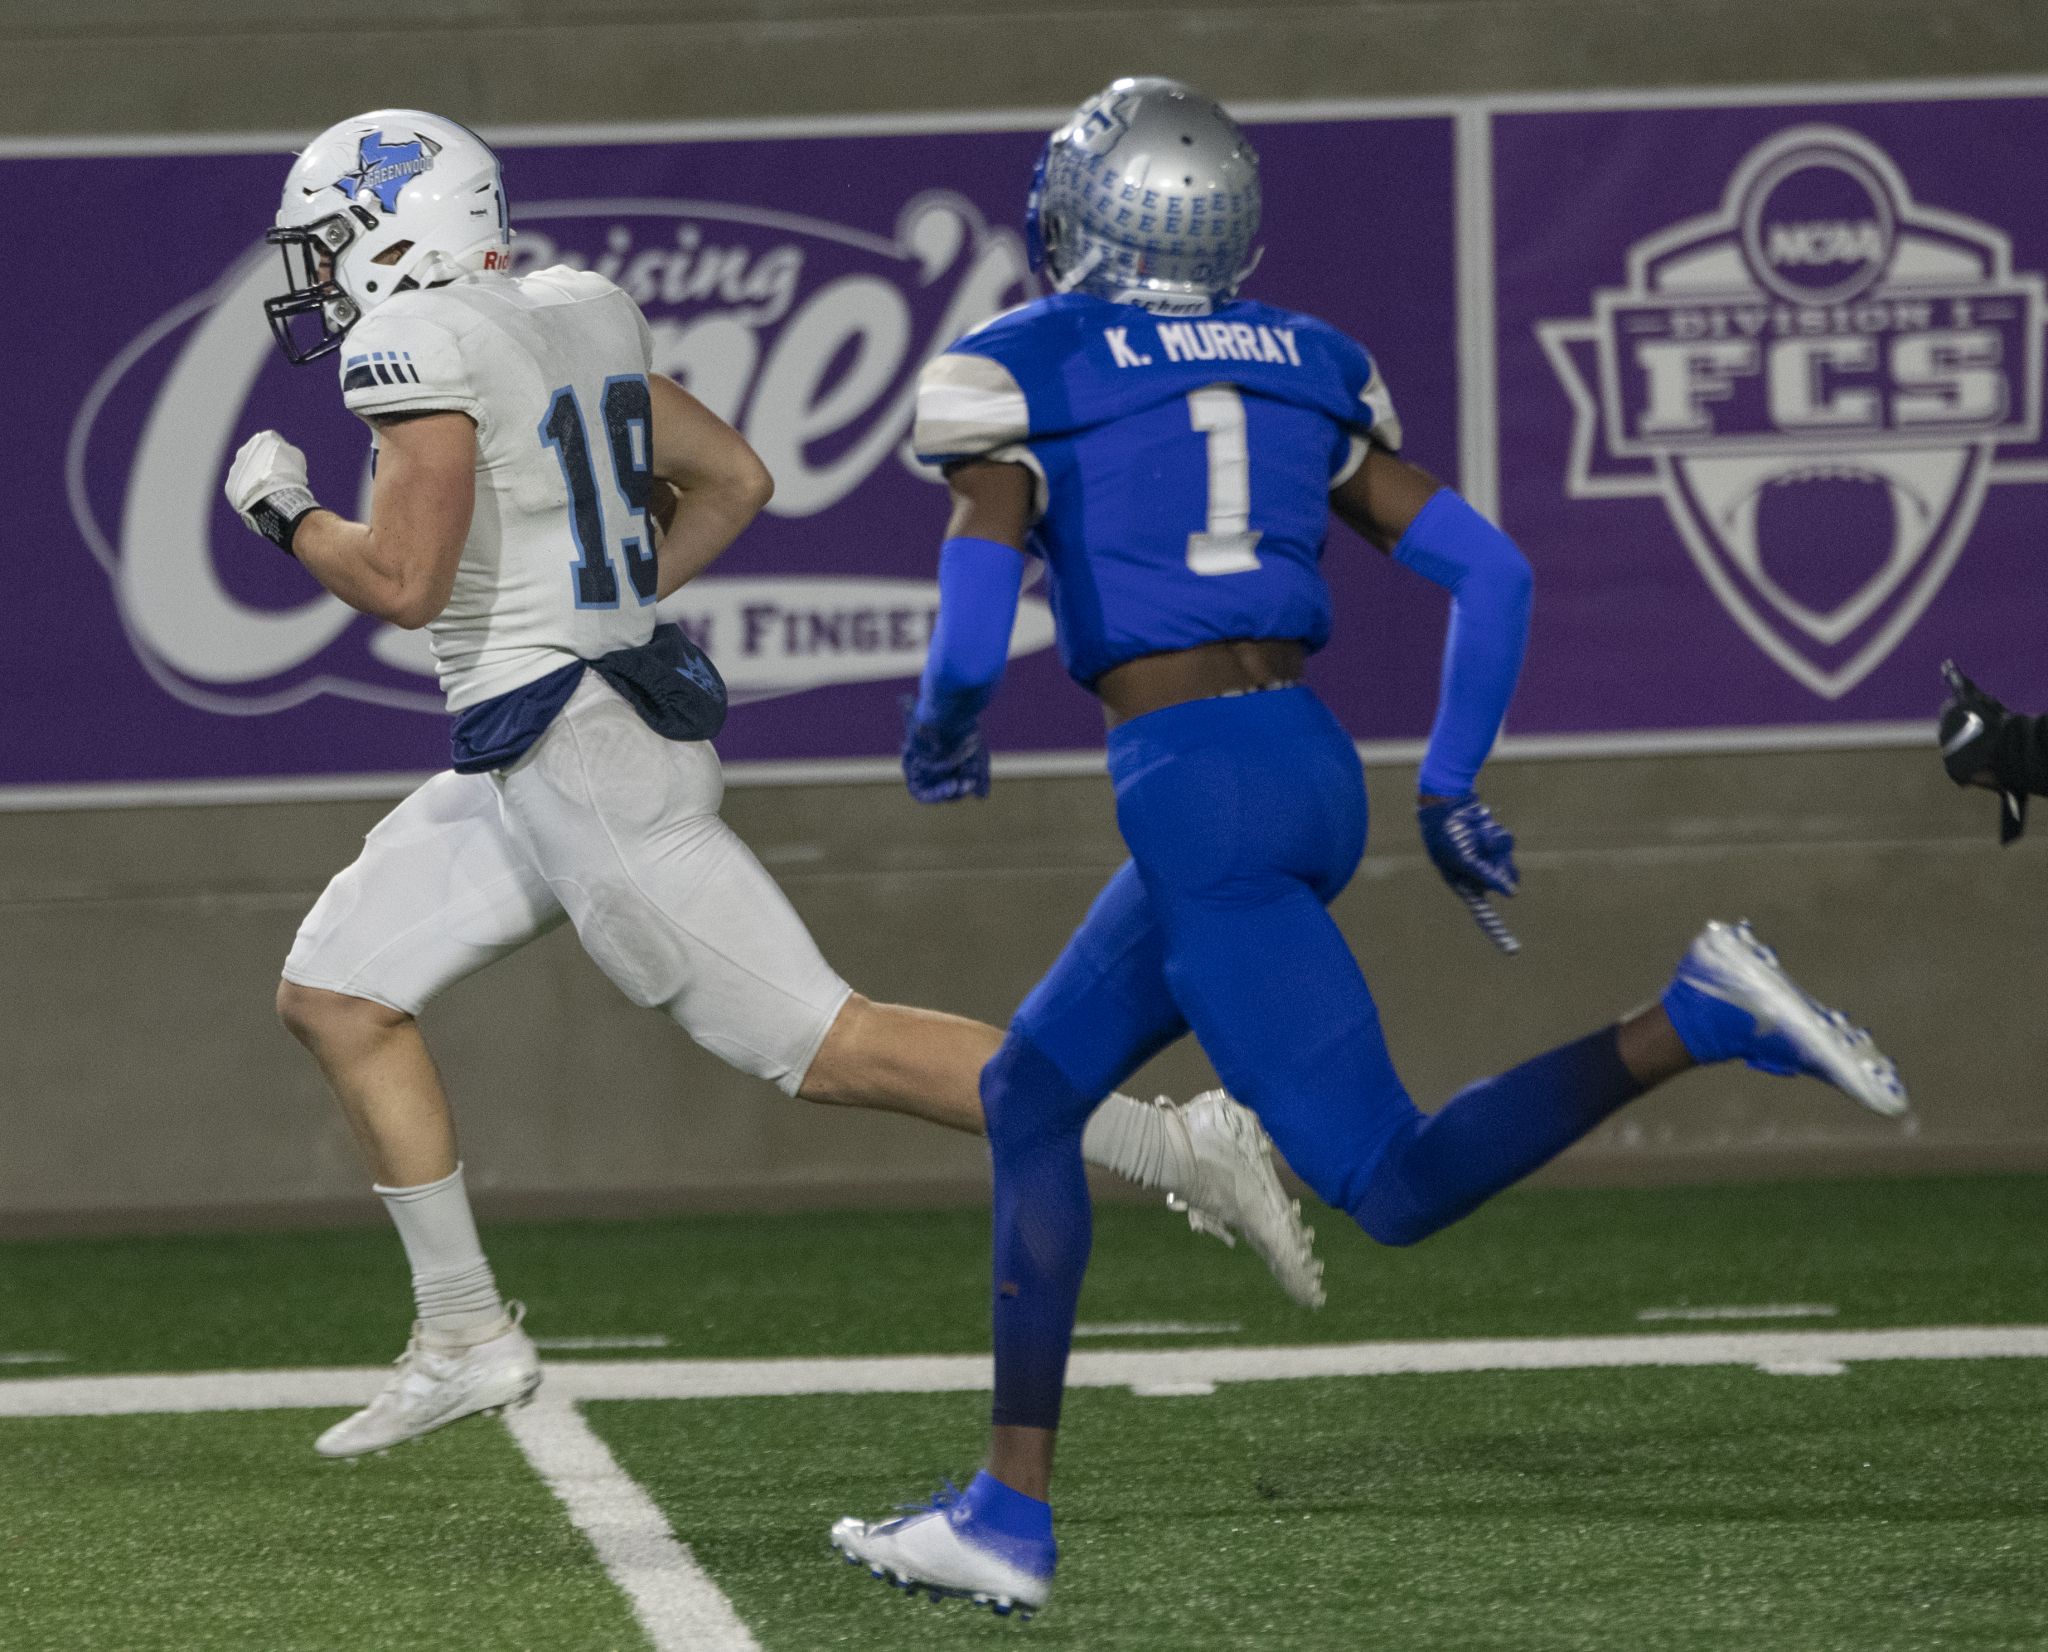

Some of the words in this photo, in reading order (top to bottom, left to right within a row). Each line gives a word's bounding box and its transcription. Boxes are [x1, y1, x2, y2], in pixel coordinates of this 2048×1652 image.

[366, 156, 434, 187] GREENWOOD
[511, 224, 803, 328] ising
[1104, 326, 1152, 368] K.
[1156, 321, 1301, 367] MURRAY
[1670, 303, 1931, 338] DIVISION
[1636, 331, 2008, 436] FCS
[538, 373, 657, 610] 19
[1186, 385, 1262, 576] 1
[741, 603, 939, 657] FINGE
